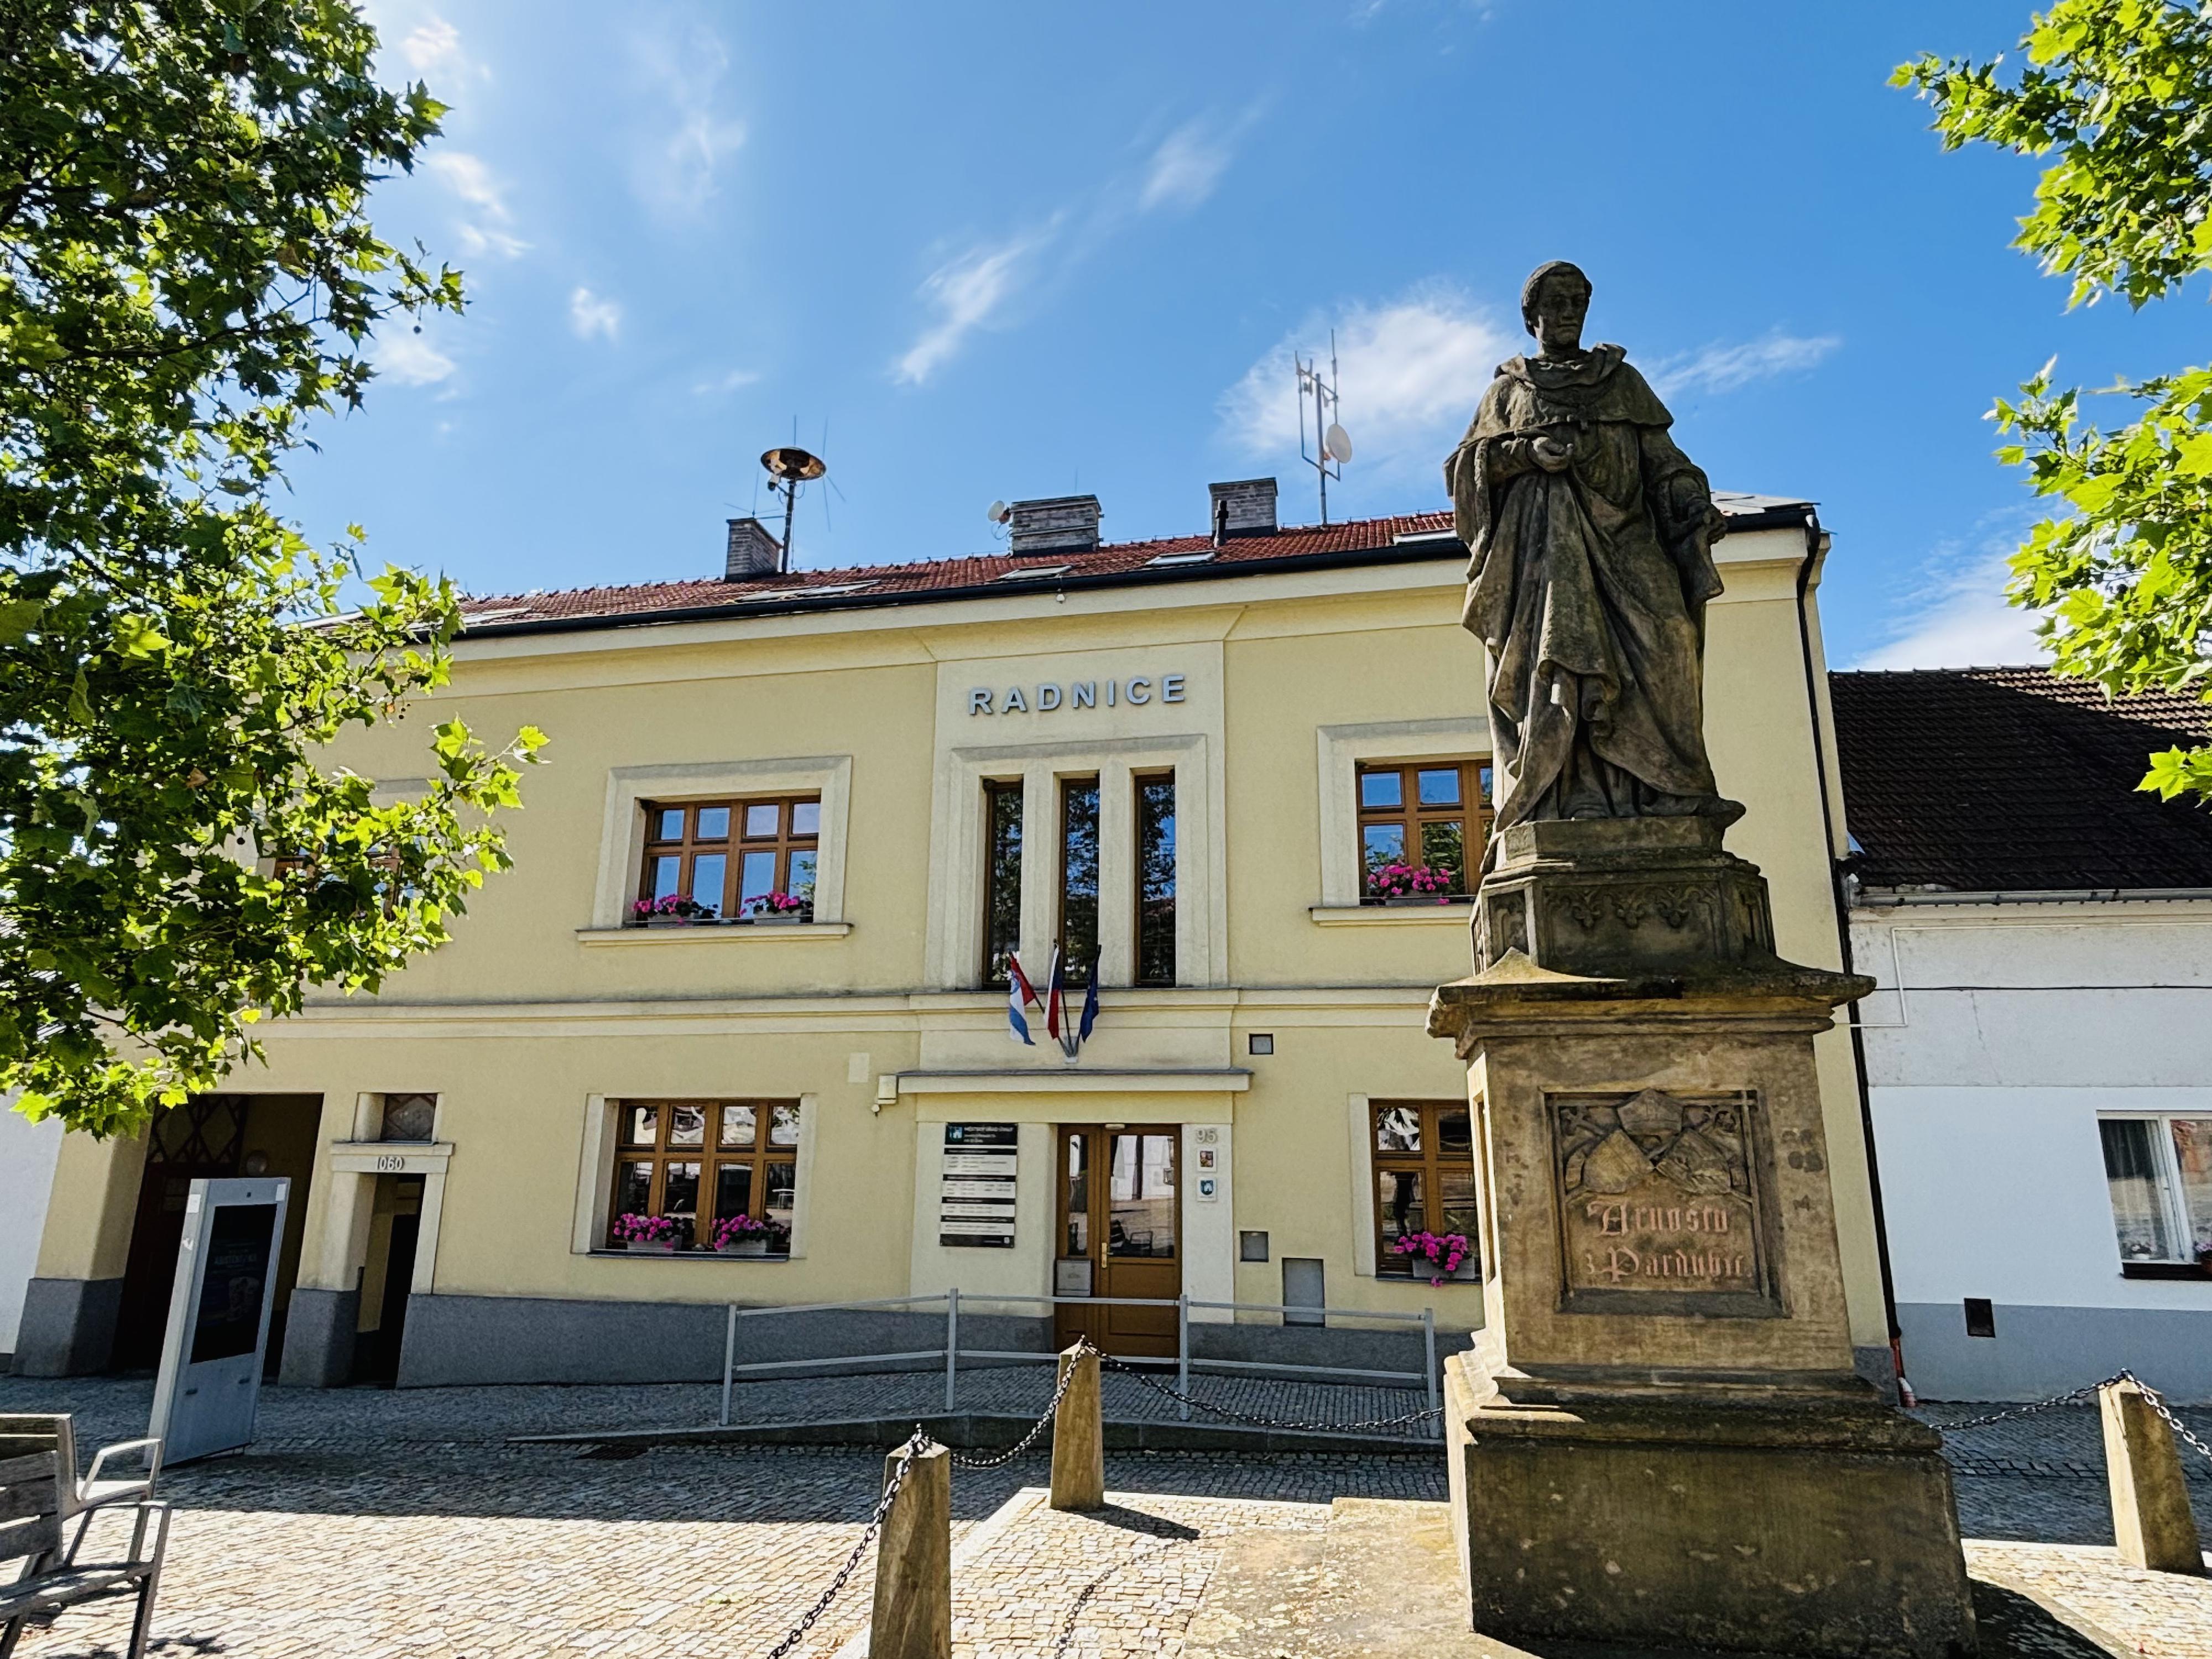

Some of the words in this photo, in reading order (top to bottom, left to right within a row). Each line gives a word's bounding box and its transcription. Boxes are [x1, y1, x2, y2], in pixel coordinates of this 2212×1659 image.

[968, 675, 1185, 716] RADNICE
[1196, 1129, 1218, 1143] 95
[376, 1156, 405, 1170] 1060
